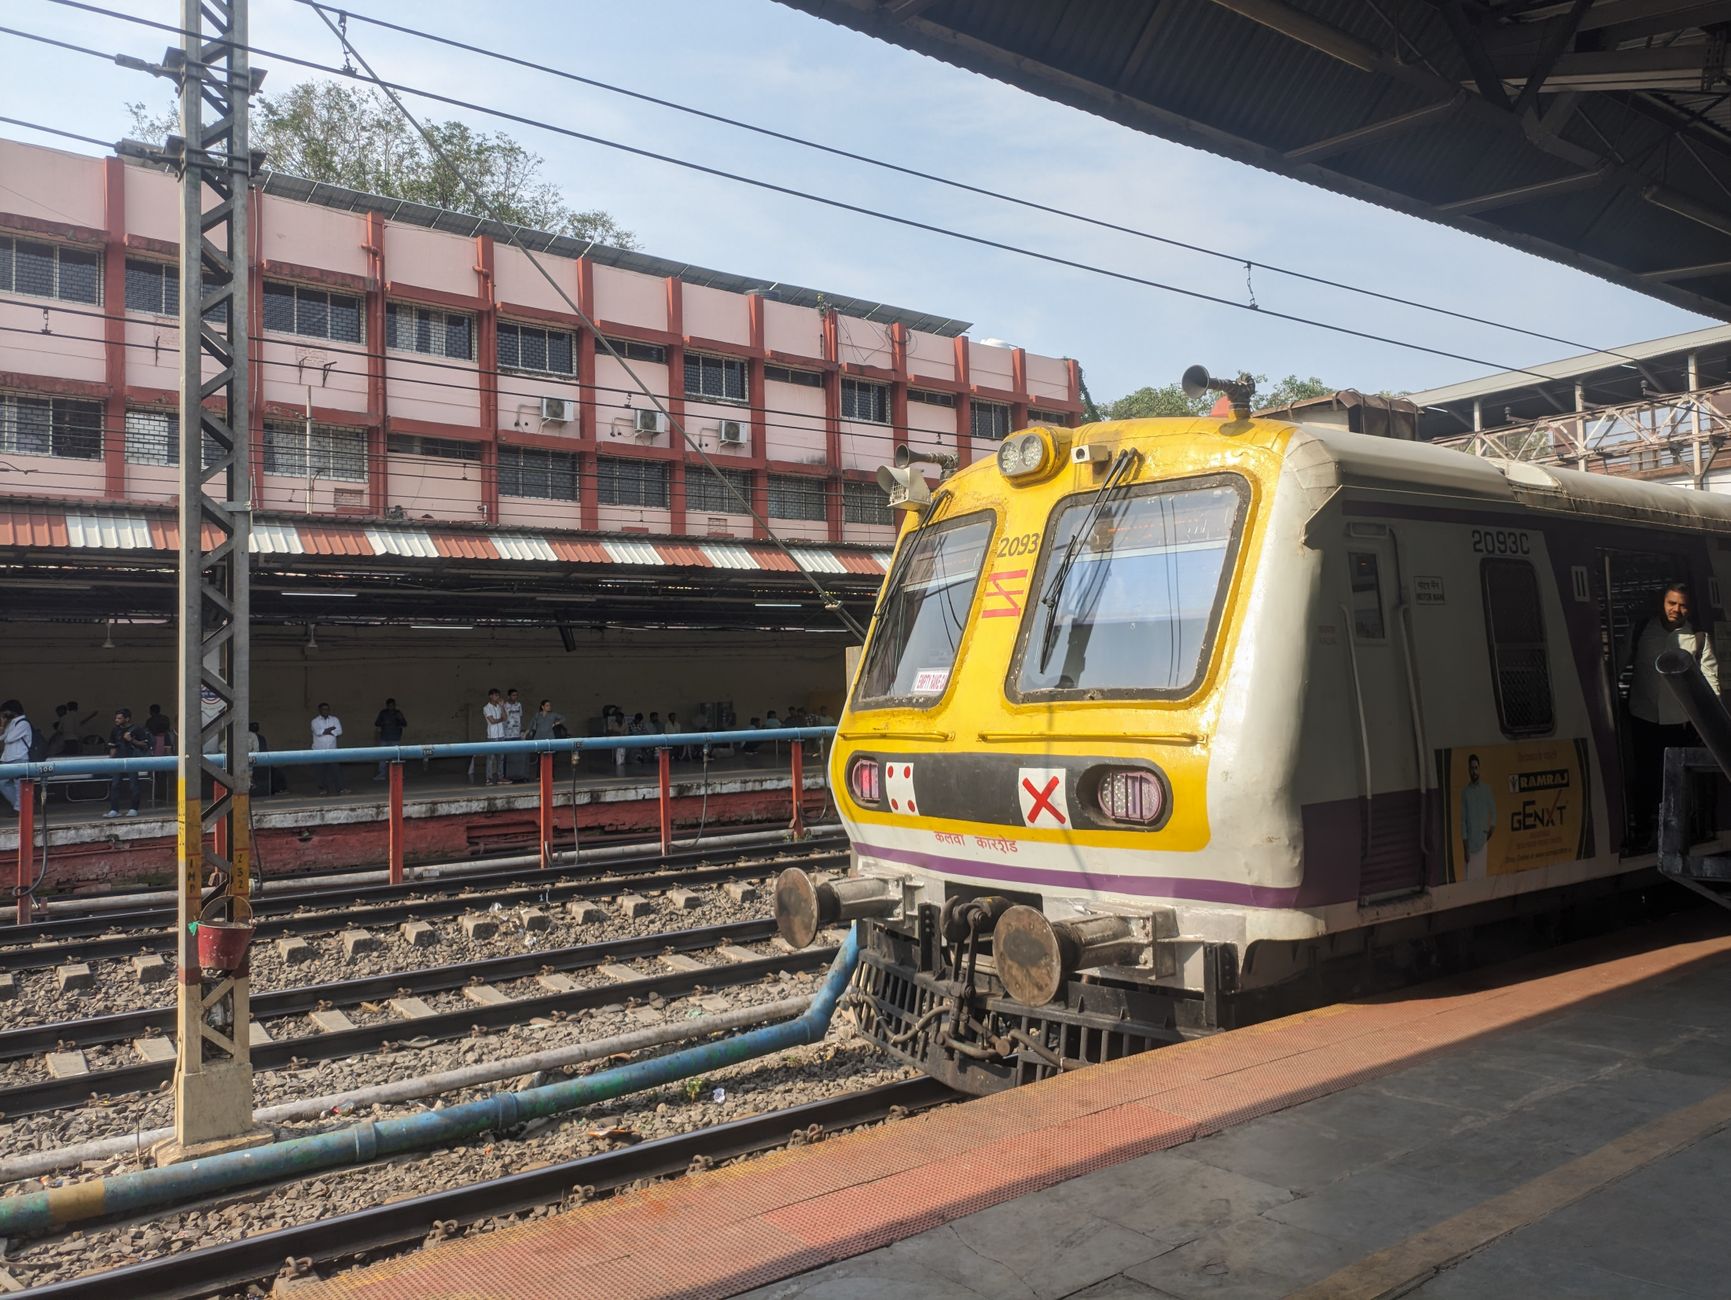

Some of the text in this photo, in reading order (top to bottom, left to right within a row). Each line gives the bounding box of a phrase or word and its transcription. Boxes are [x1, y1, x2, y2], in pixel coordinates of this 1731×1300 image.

[997, 532, 1040, 558] 2093
[1472, 529, 1530, 555] 2093C
[1519, 772, 1569, 788] RAMRAJ
[934, 831, 965, 846] कलवा
